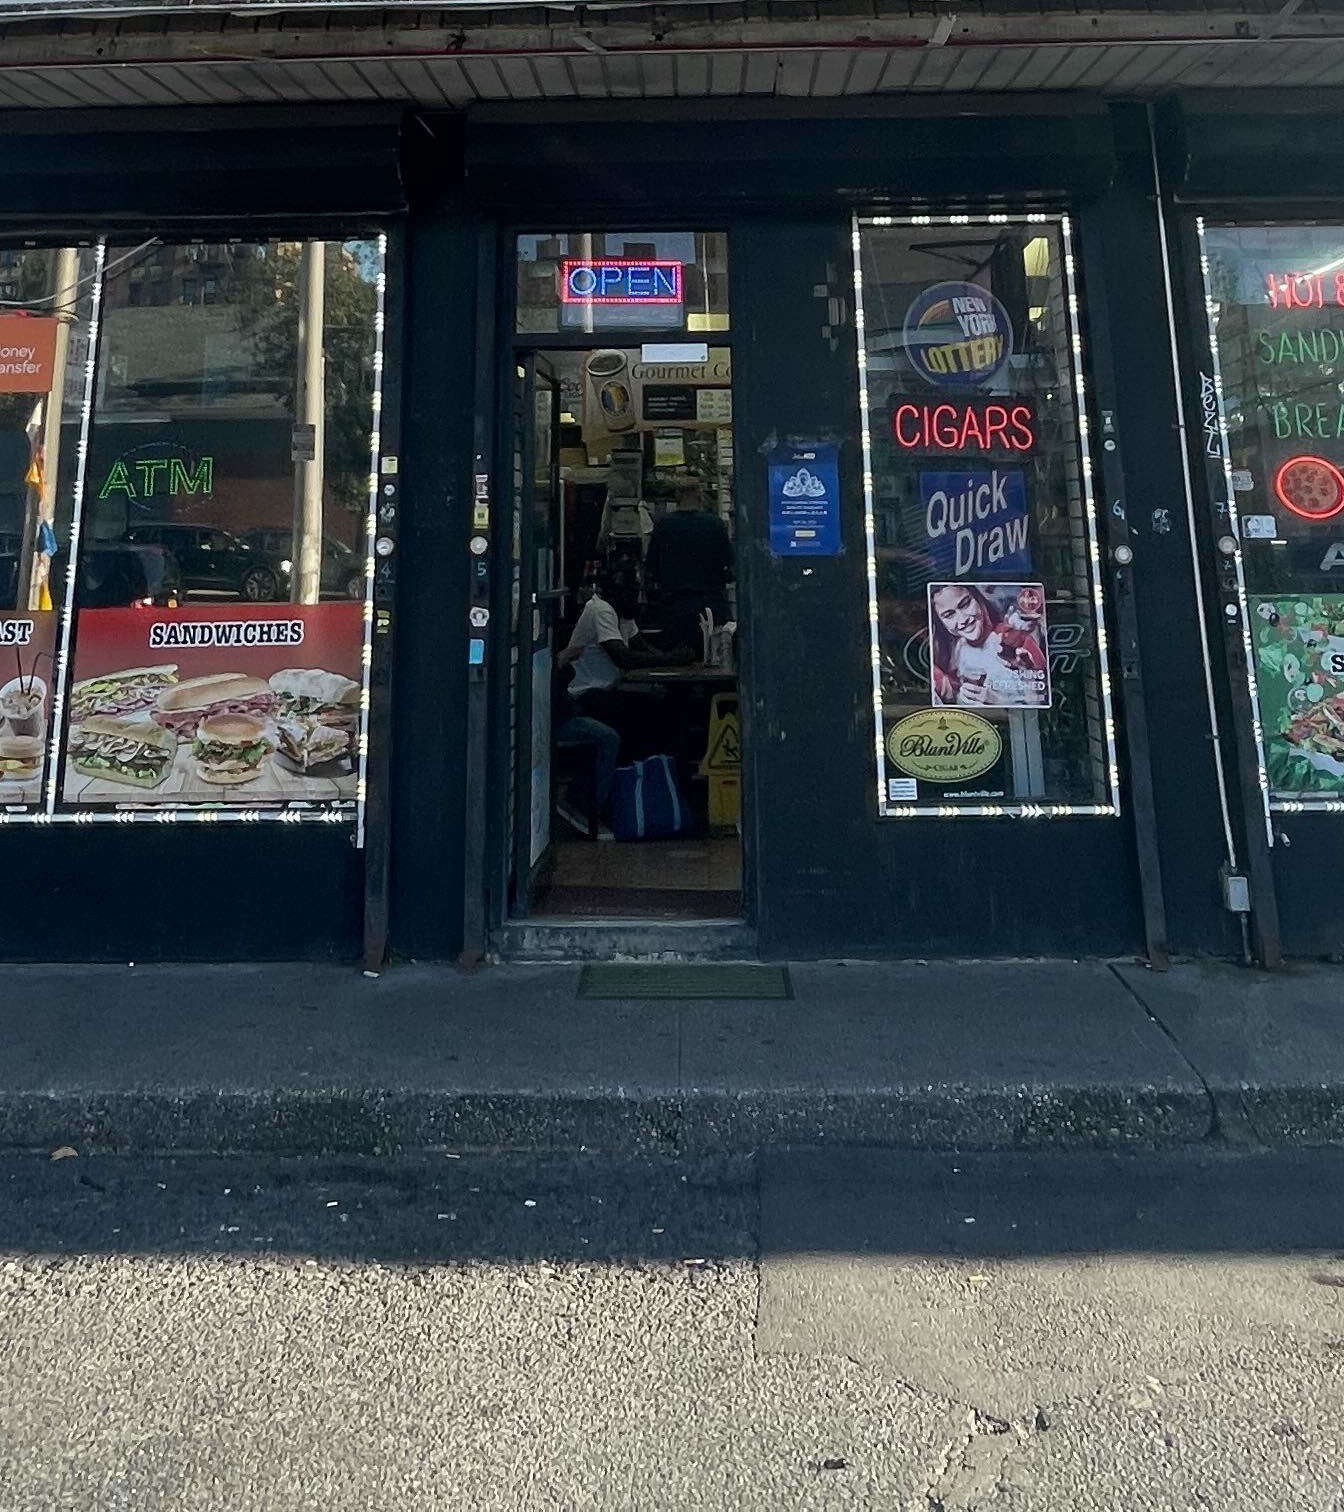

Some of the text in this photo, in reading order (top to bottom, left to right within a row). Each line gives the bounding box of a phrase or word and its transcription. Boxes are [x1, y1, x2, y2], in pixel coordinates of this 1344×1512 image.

[569, 267, 676, 295] OPEN
[1266, 274, 1324, 309] HOT
[952, 297, 985, 313] NEW
[957, 313, 997, 337] YORK
[632, 363, 705, 379] Gourmet
[921, 337, 1003, 374] LOTTERY
[895, 404, 1033, 450] CIGARS
[99, 458, 213, 499] ATM
[926, 470, 1007, 538] Quick
[955, 514, 1029, 576] Draw
[150, 620, 304, 647] SANDWICHES
[899, 731, 985, 757] BluntVille
